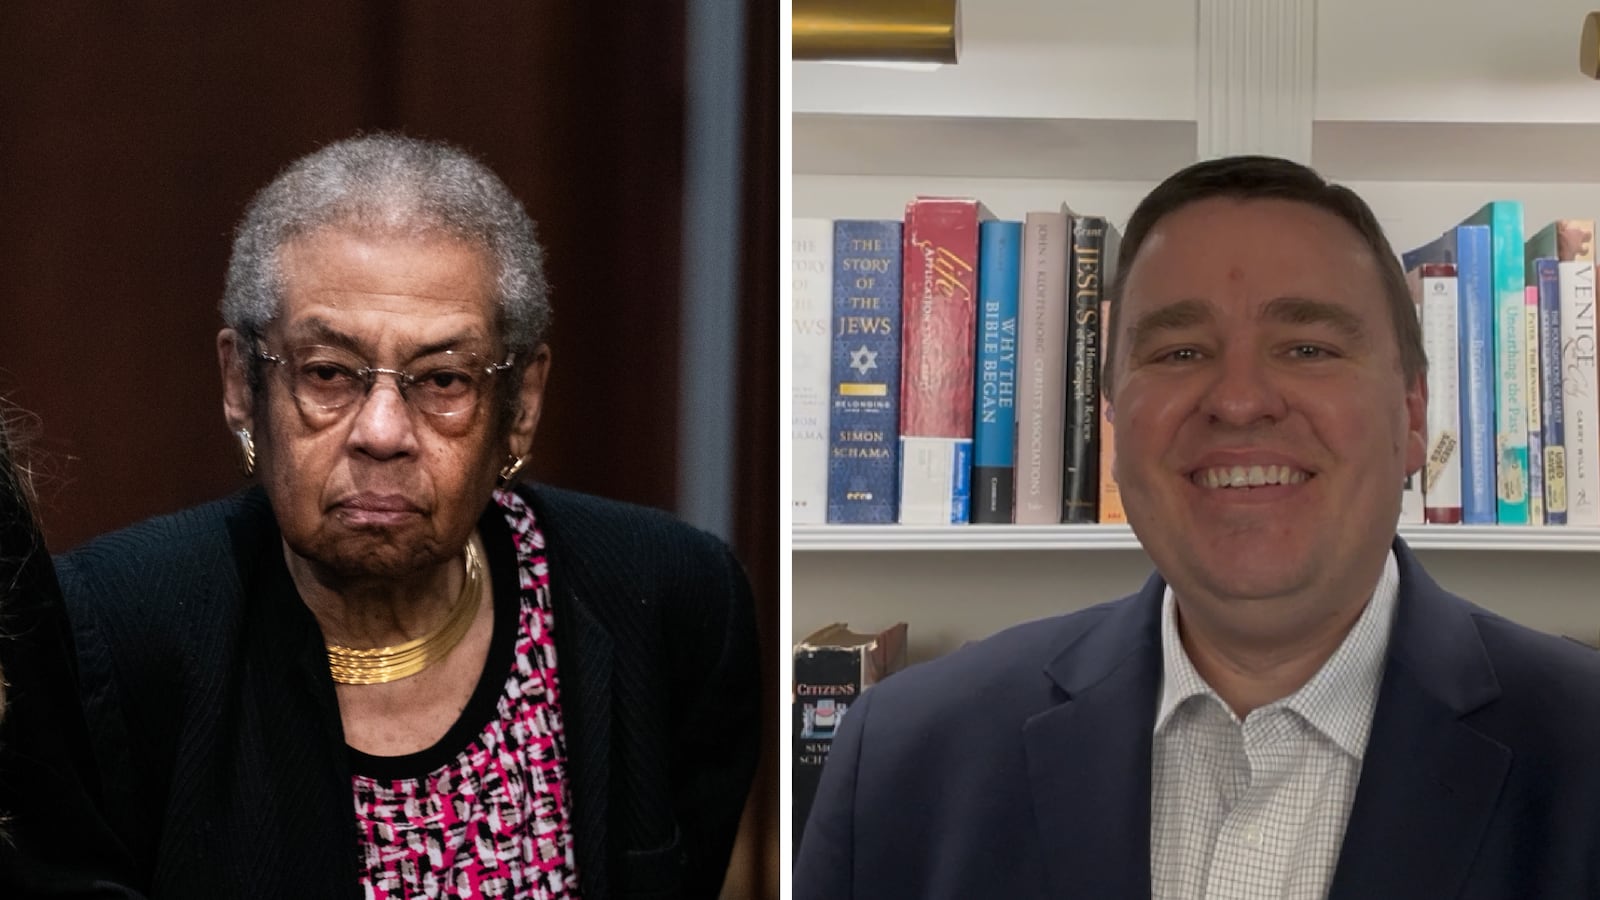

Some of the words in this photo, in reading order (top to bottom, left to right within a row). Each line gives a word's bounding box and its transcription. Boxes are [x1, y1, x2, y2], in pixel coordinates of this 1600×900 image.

[851, 239, 882, 252] THE
[843, 257, 892, 274] STORY
[931, 246, 974, 301] life
[855, 278, 876, 289] OF
[1074, 244, 1099, 325] JESUS
[849, 297, 881, 310] THE
[1574, 265, 1596, 368] VENICE
[839, 316, 892, 336] JEWS
[984, 301, 1000, 354] BIBLE
[1000, 316, 1016, 364] WHY
[1504, 306, 1520, 381] Unearthing
[981, 360, 998, 423] BEGAN
[999, 367, 1014, 409] THE
[1508, 383, 1521, 405] the
[1509, 407, 1522, 434] Past
[839, 430, 884, 443] SIMON
[832, 447, 890, 459] SCHAMA
[1030, 412, 1043, 495] ASSOCIATIONS
[1576, 447, 1585, 480] WILLS
[797, 683, 855, 696] CITIZENS
